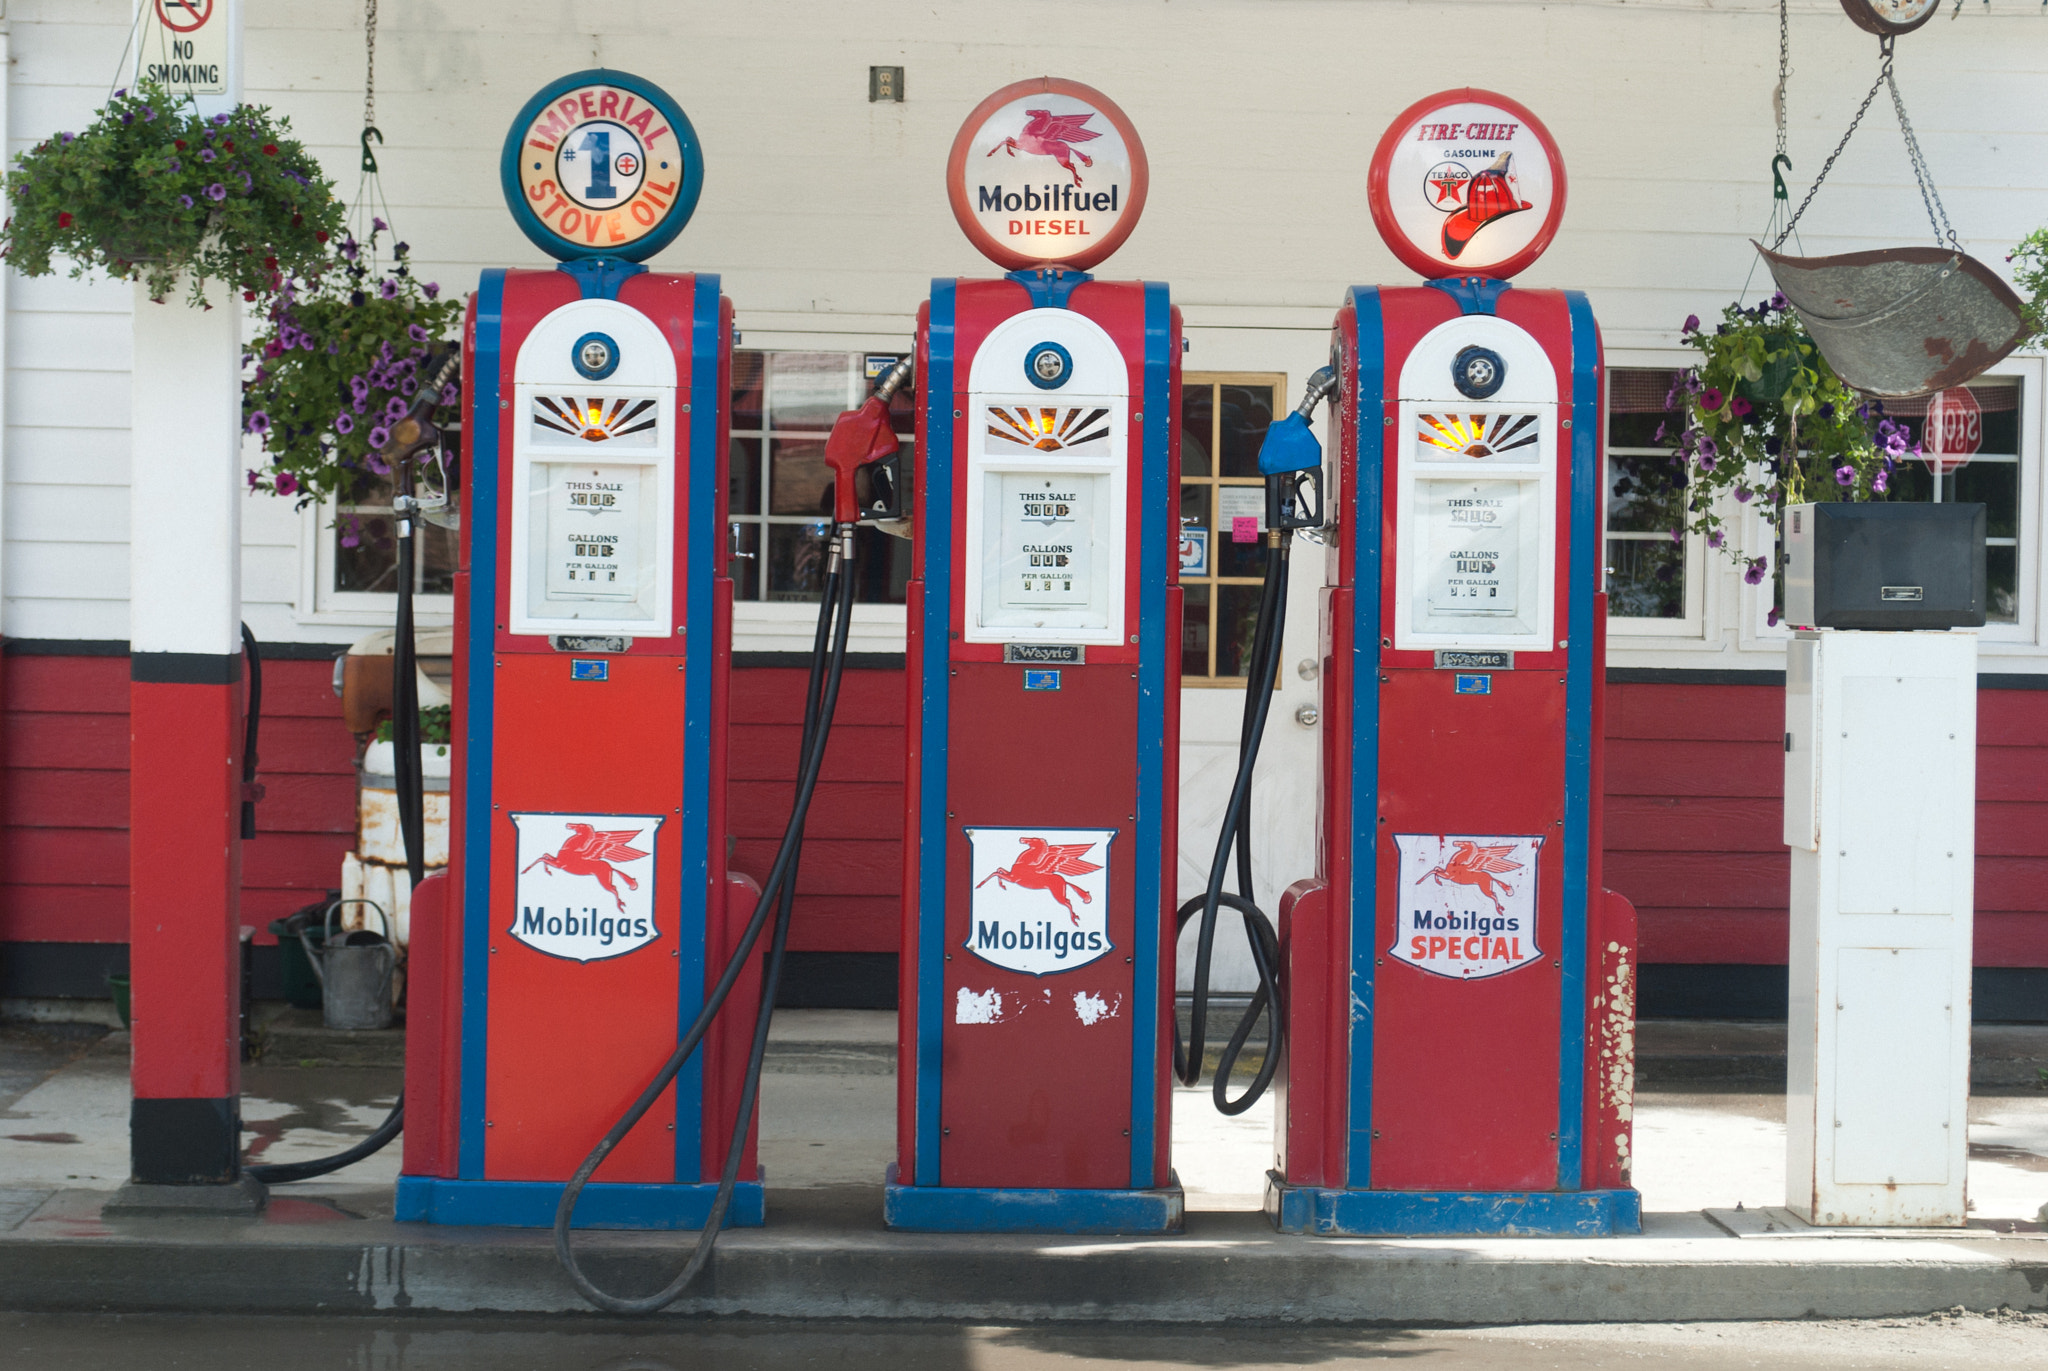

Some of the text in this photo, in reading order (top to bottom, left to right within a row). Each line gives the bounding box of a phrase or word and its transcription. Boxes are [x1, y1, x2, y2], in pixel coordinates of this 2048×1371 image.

[173, 40, 194, 60] NO
[147, 64, 219, 84] SMOKING
[528, 90, 669, 152] IMPERIAL
[1417, 123, 1518, 141] FIRE-CHIEF
[1443, 149, 1496, 158] GASOLINE
[1431, 171, 1469, 179] TEXACO
[979, 184, 1118, 212] Mobilfuel
[529, 178, 676, 243] STOVE OIL
[1008, 220, 1090, 236] DIESEL
[565, 481, 624, 492] THIS SALE
[1019, 493, 1076, 501] THIS SALE
[1446, 499, 1503, 508] THIS SALE
[568, 534, 619, 543] GALLONS
[1022, 545, 1073, 553] GALLONS
[1449, 551, 1499, 559] GALLONS
[1019, 646, 1072, 660] Wayne
[1449, 653, 1501, 665] Wayne
[523, 906, 648, 946] Mobilgas
[1413, 909, 1520, 936] Mobilgas
[978, 920, 1102, 959] Mobilgas
[1411, 935, 1524, 960] SPECIAL
